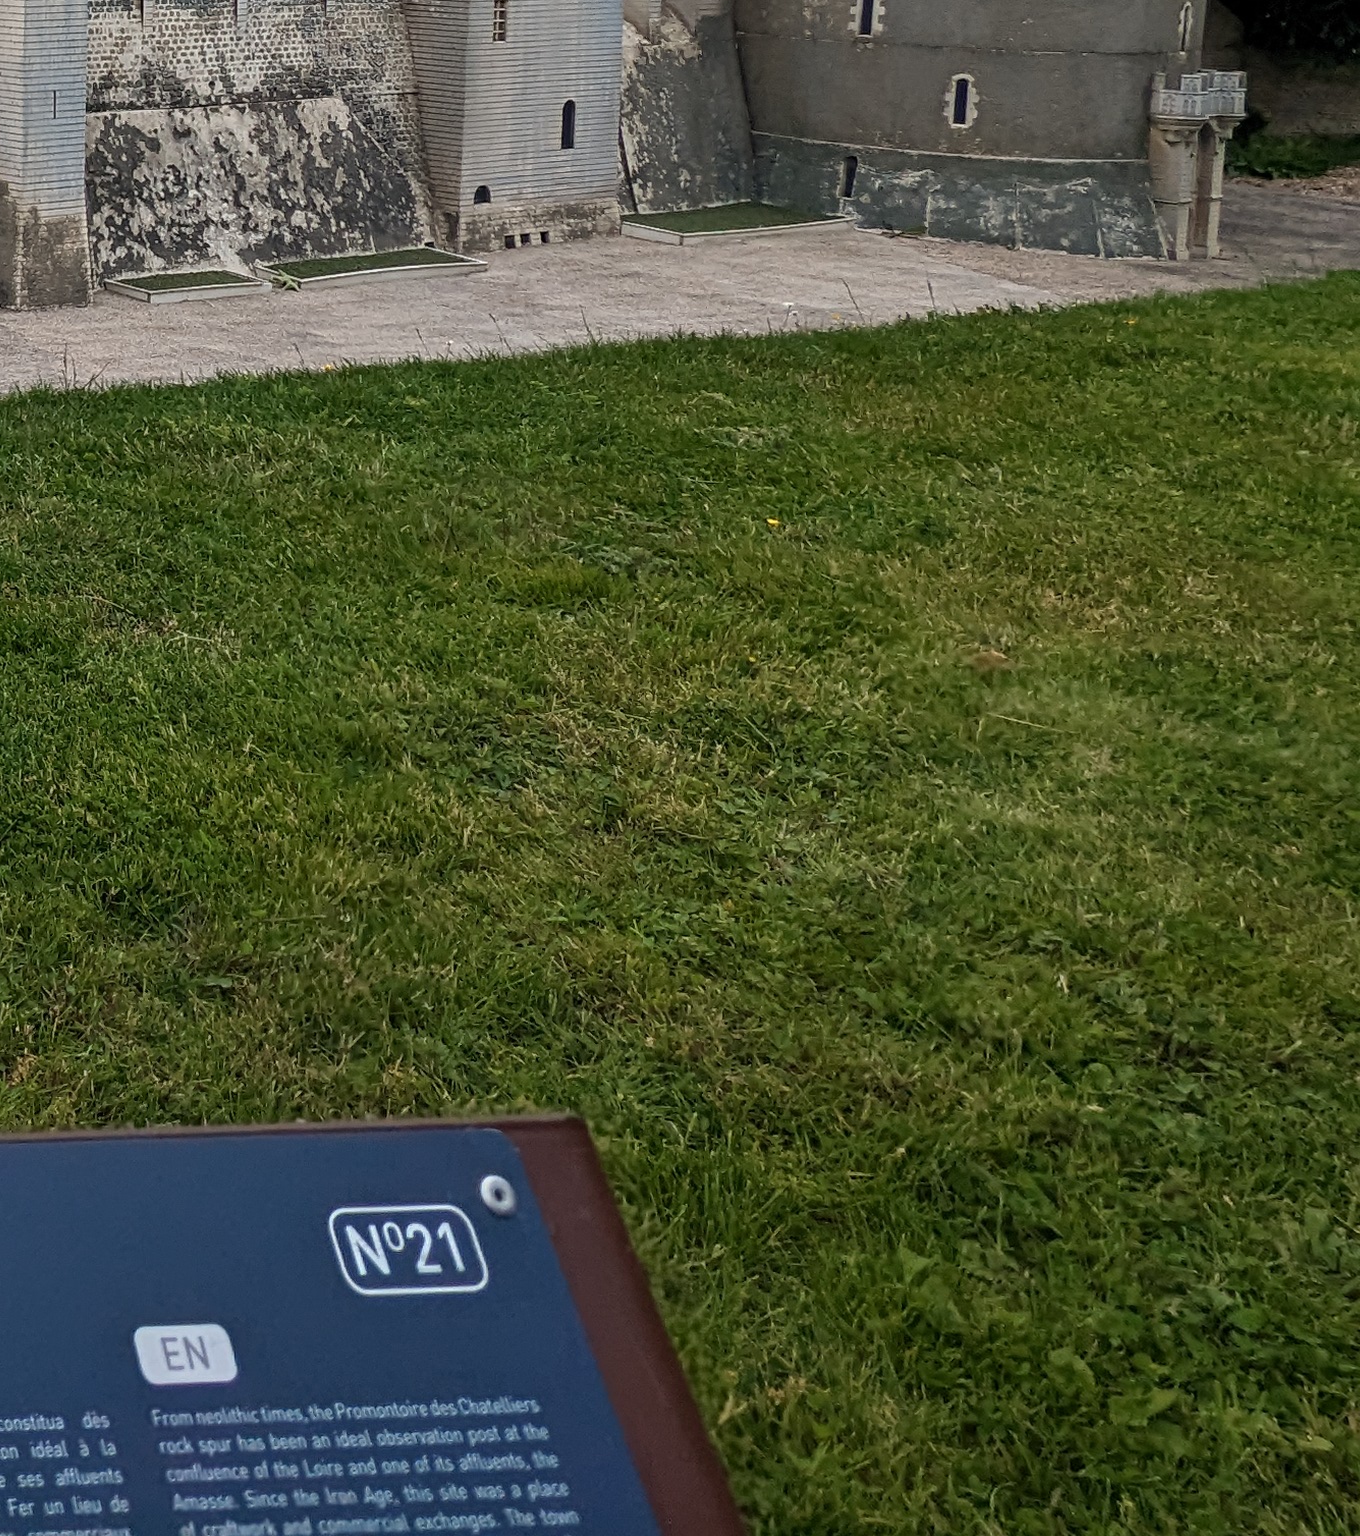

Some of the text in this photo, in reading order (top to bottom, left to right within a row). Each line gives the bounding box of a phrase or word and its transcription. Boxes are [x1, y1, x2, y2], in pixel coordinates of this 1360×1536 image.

[161, 1336, 210, 1371] EN
[82, 1411, 110, 1429] dès
[152, 1409, 193, 1426] From
[196, 1406, 259, 1425] neolithic
[308, 1404, 334, 1421] the
[334, 1400, 428, 1419] Promontoire
[430, 1400, 458, 1417] des
[31, 1440, 68, 1458] idéal
[80, 1440, 89, 1456] à
[100, 1439, 116, 1456] la
[159, 1423, 549, 1456] rock spur has been an ideal observation post at the
[17, 1474, 44, 1487] ses
[56, 1468, 123, 1486] affluents
[166, 1463, 249, 1482] confluence
[254, 1460, 269, 1479] of
[273, 1461, 299, 1478] the
[303, 1459, 344, 1478] Loire
[348, 1457, 377, 1476] and
[382, 1460, 410, 1474] one
[415, 1455, 430, 1473] of
[434, 1456, 455, 1472] its
[532, 1451, 559, 1468] the
[7, 1498, 34, 1516] Fer
[44, 1501, 64, 1515] un
[72, 1496, 102, 1514] lieu
[110, 1495, 129, 1513] de
[244, 1490, 288, 1508] Since
[293, 1489, 319, 1506] the
[403, 1484, 433, 1502] this
[439, 1483, 468, 1501] site
[474, 1486, 505, 1499] was
[511, 1485, 522, 1498] a
[528, 1479, 569, 1501] place
